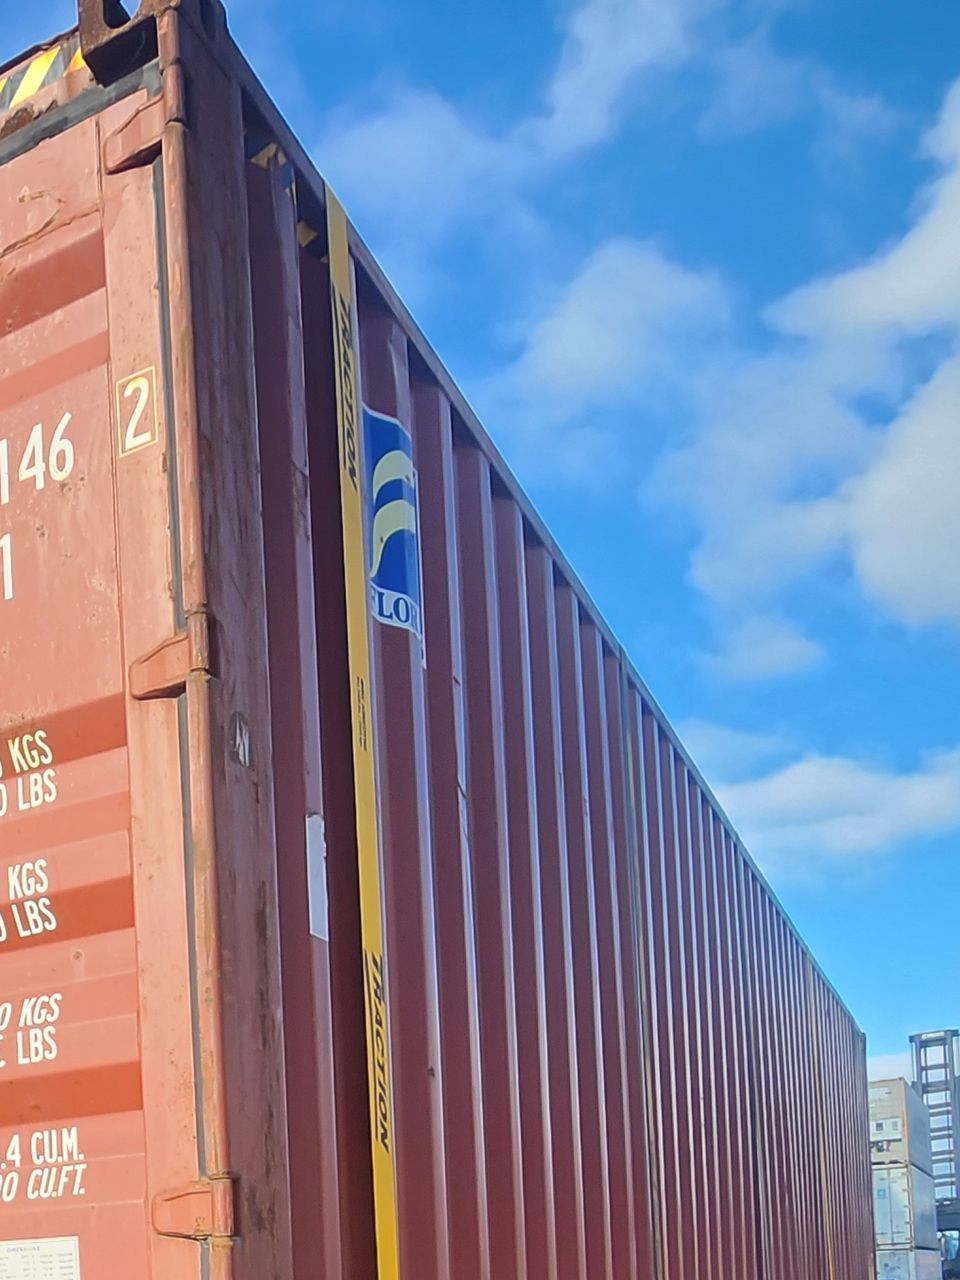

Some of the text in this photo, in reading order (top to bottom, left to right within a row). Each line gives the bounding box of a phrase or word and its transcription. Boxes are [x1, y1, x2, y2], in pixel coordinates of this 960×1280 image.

[122, 376, 153, 451] 2
[8, 730, 53, 781] KGS
[17, 768, 57, 811] LBS
[7, 858, 49, 900] KGS
[11, 897, 57, 938] LBS
[19, 993, 63, 1028] KGS
[17, 1026, 58, 1065] LBS
[372, 952, 390, 1153] TRACTION
